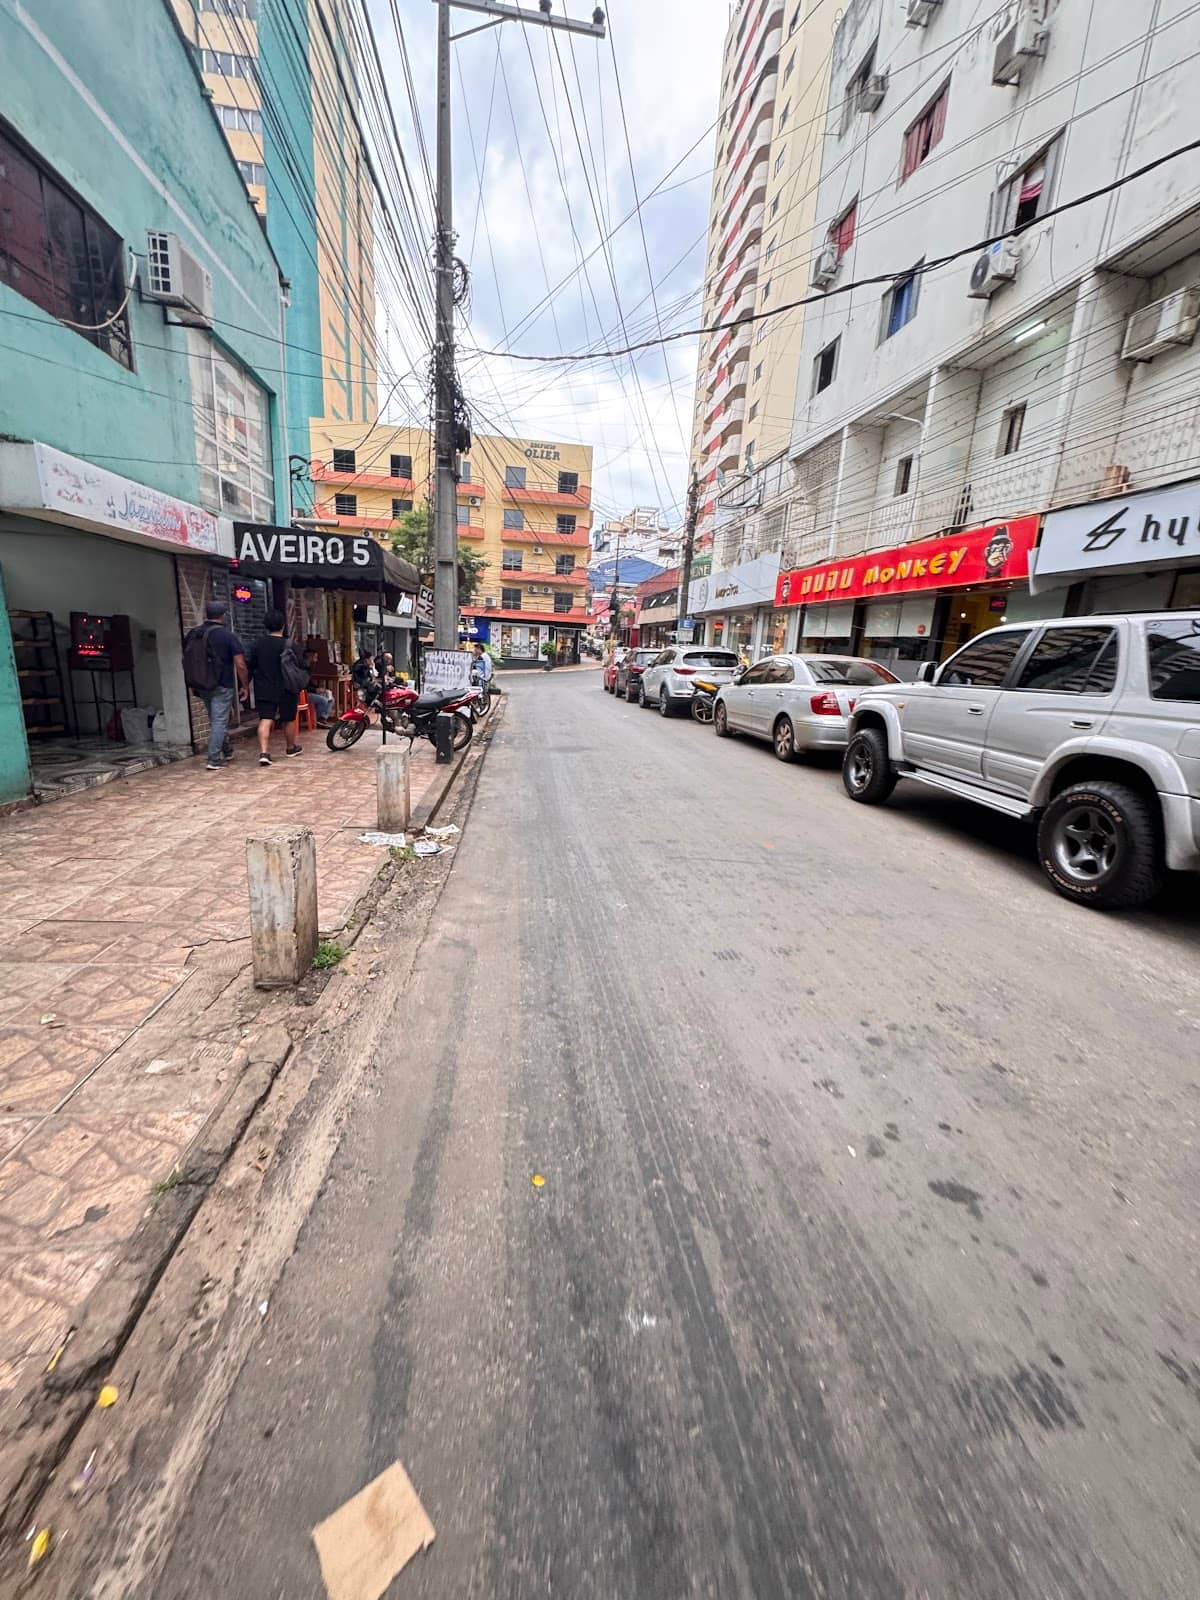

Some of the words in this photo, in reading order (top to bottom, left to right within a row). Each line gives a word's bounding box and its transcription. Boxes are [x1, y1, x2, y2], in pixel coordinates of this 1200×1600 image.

[524, 449, 560, 460] OLIER
[1140, 512, 1200, 546] hy
[240, 531, 345, 565] AVEIRO
[352, 538, 371, 566] 5
[862, 547, 969, 587] MONKEY
[425, 663, 461, 676] AVEIRO
